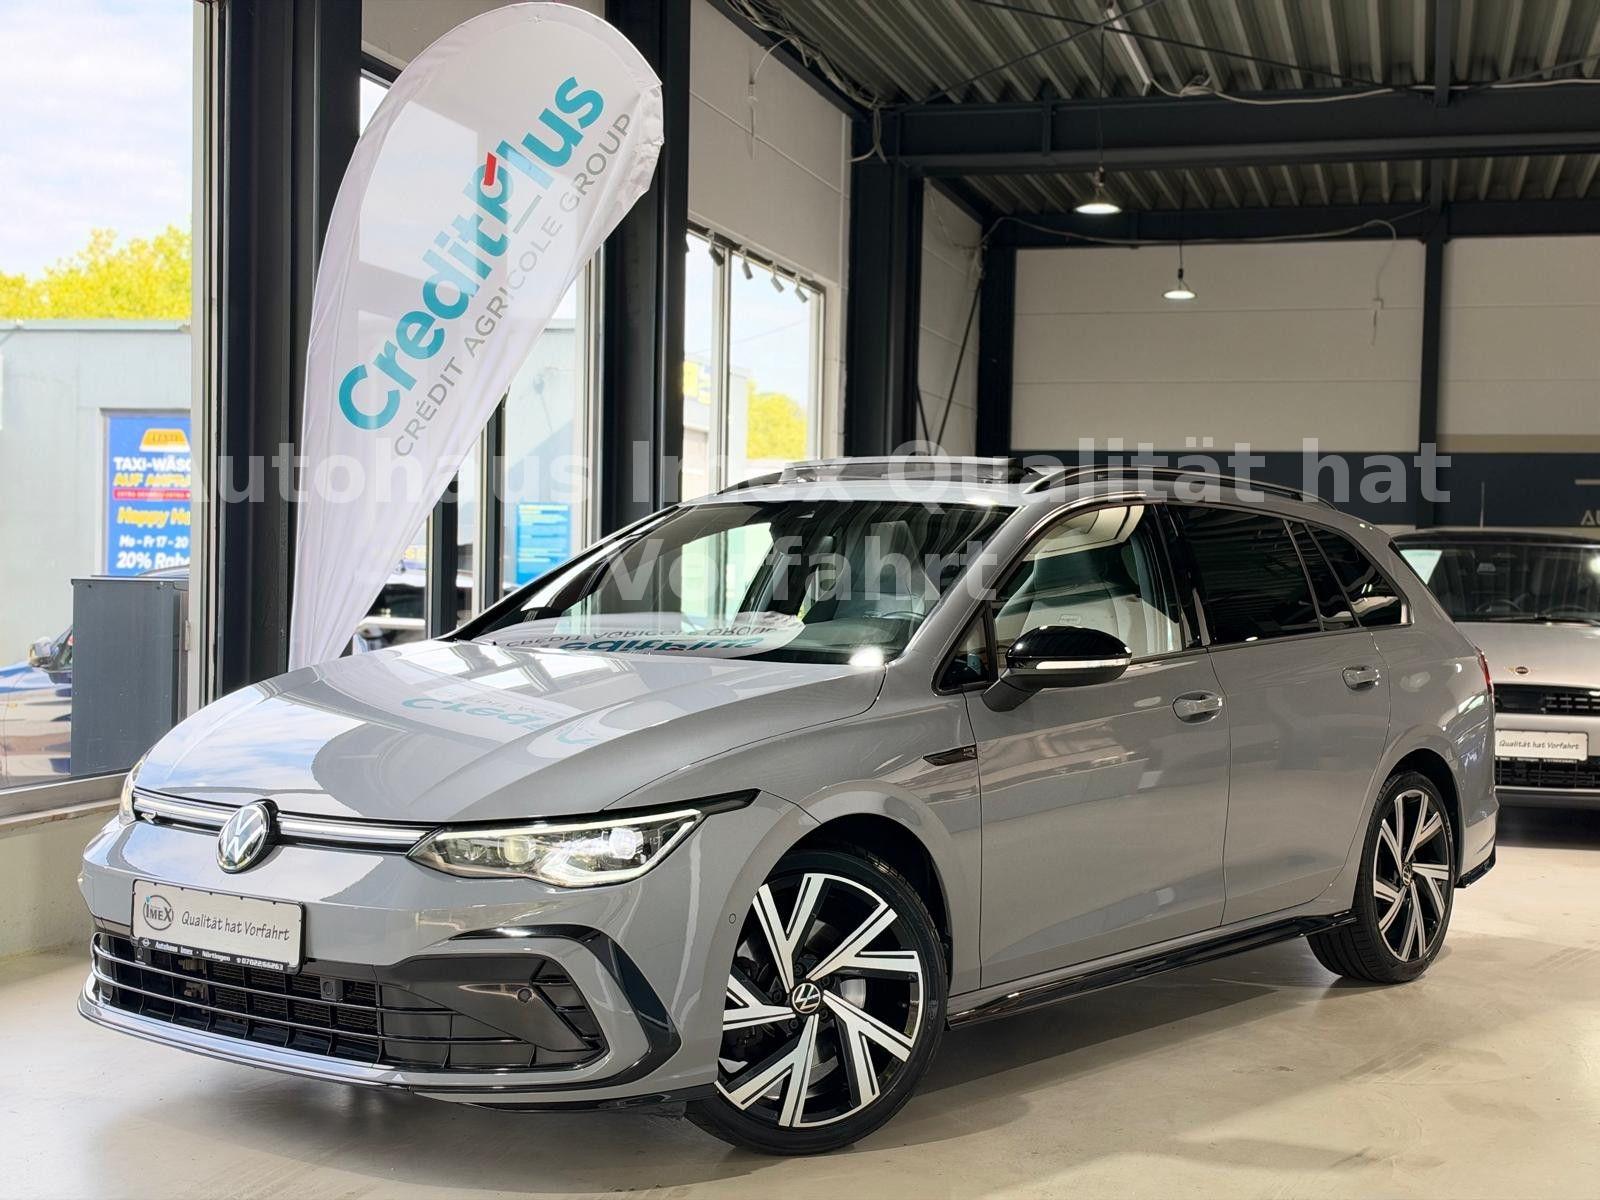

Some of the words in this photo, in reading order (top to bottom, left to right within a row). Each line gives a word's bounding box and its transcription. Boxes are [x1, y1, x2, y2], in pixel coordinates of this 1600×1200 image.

[338, 76, 604, 431] CreditPlus
[395, 355, 464, 457] CRÉDIT
[463, 215, 563, 359] AGRICOLE
[559, 113, 633, 213] GROUP
[117, 506, 170, 528] Happy
[116, 551, 153, 569] 20%
[181, 910, 223, 931] Qualität
[224, 917, 243, 934] hat
[243, 921, 290, 942] Vorfahrt
